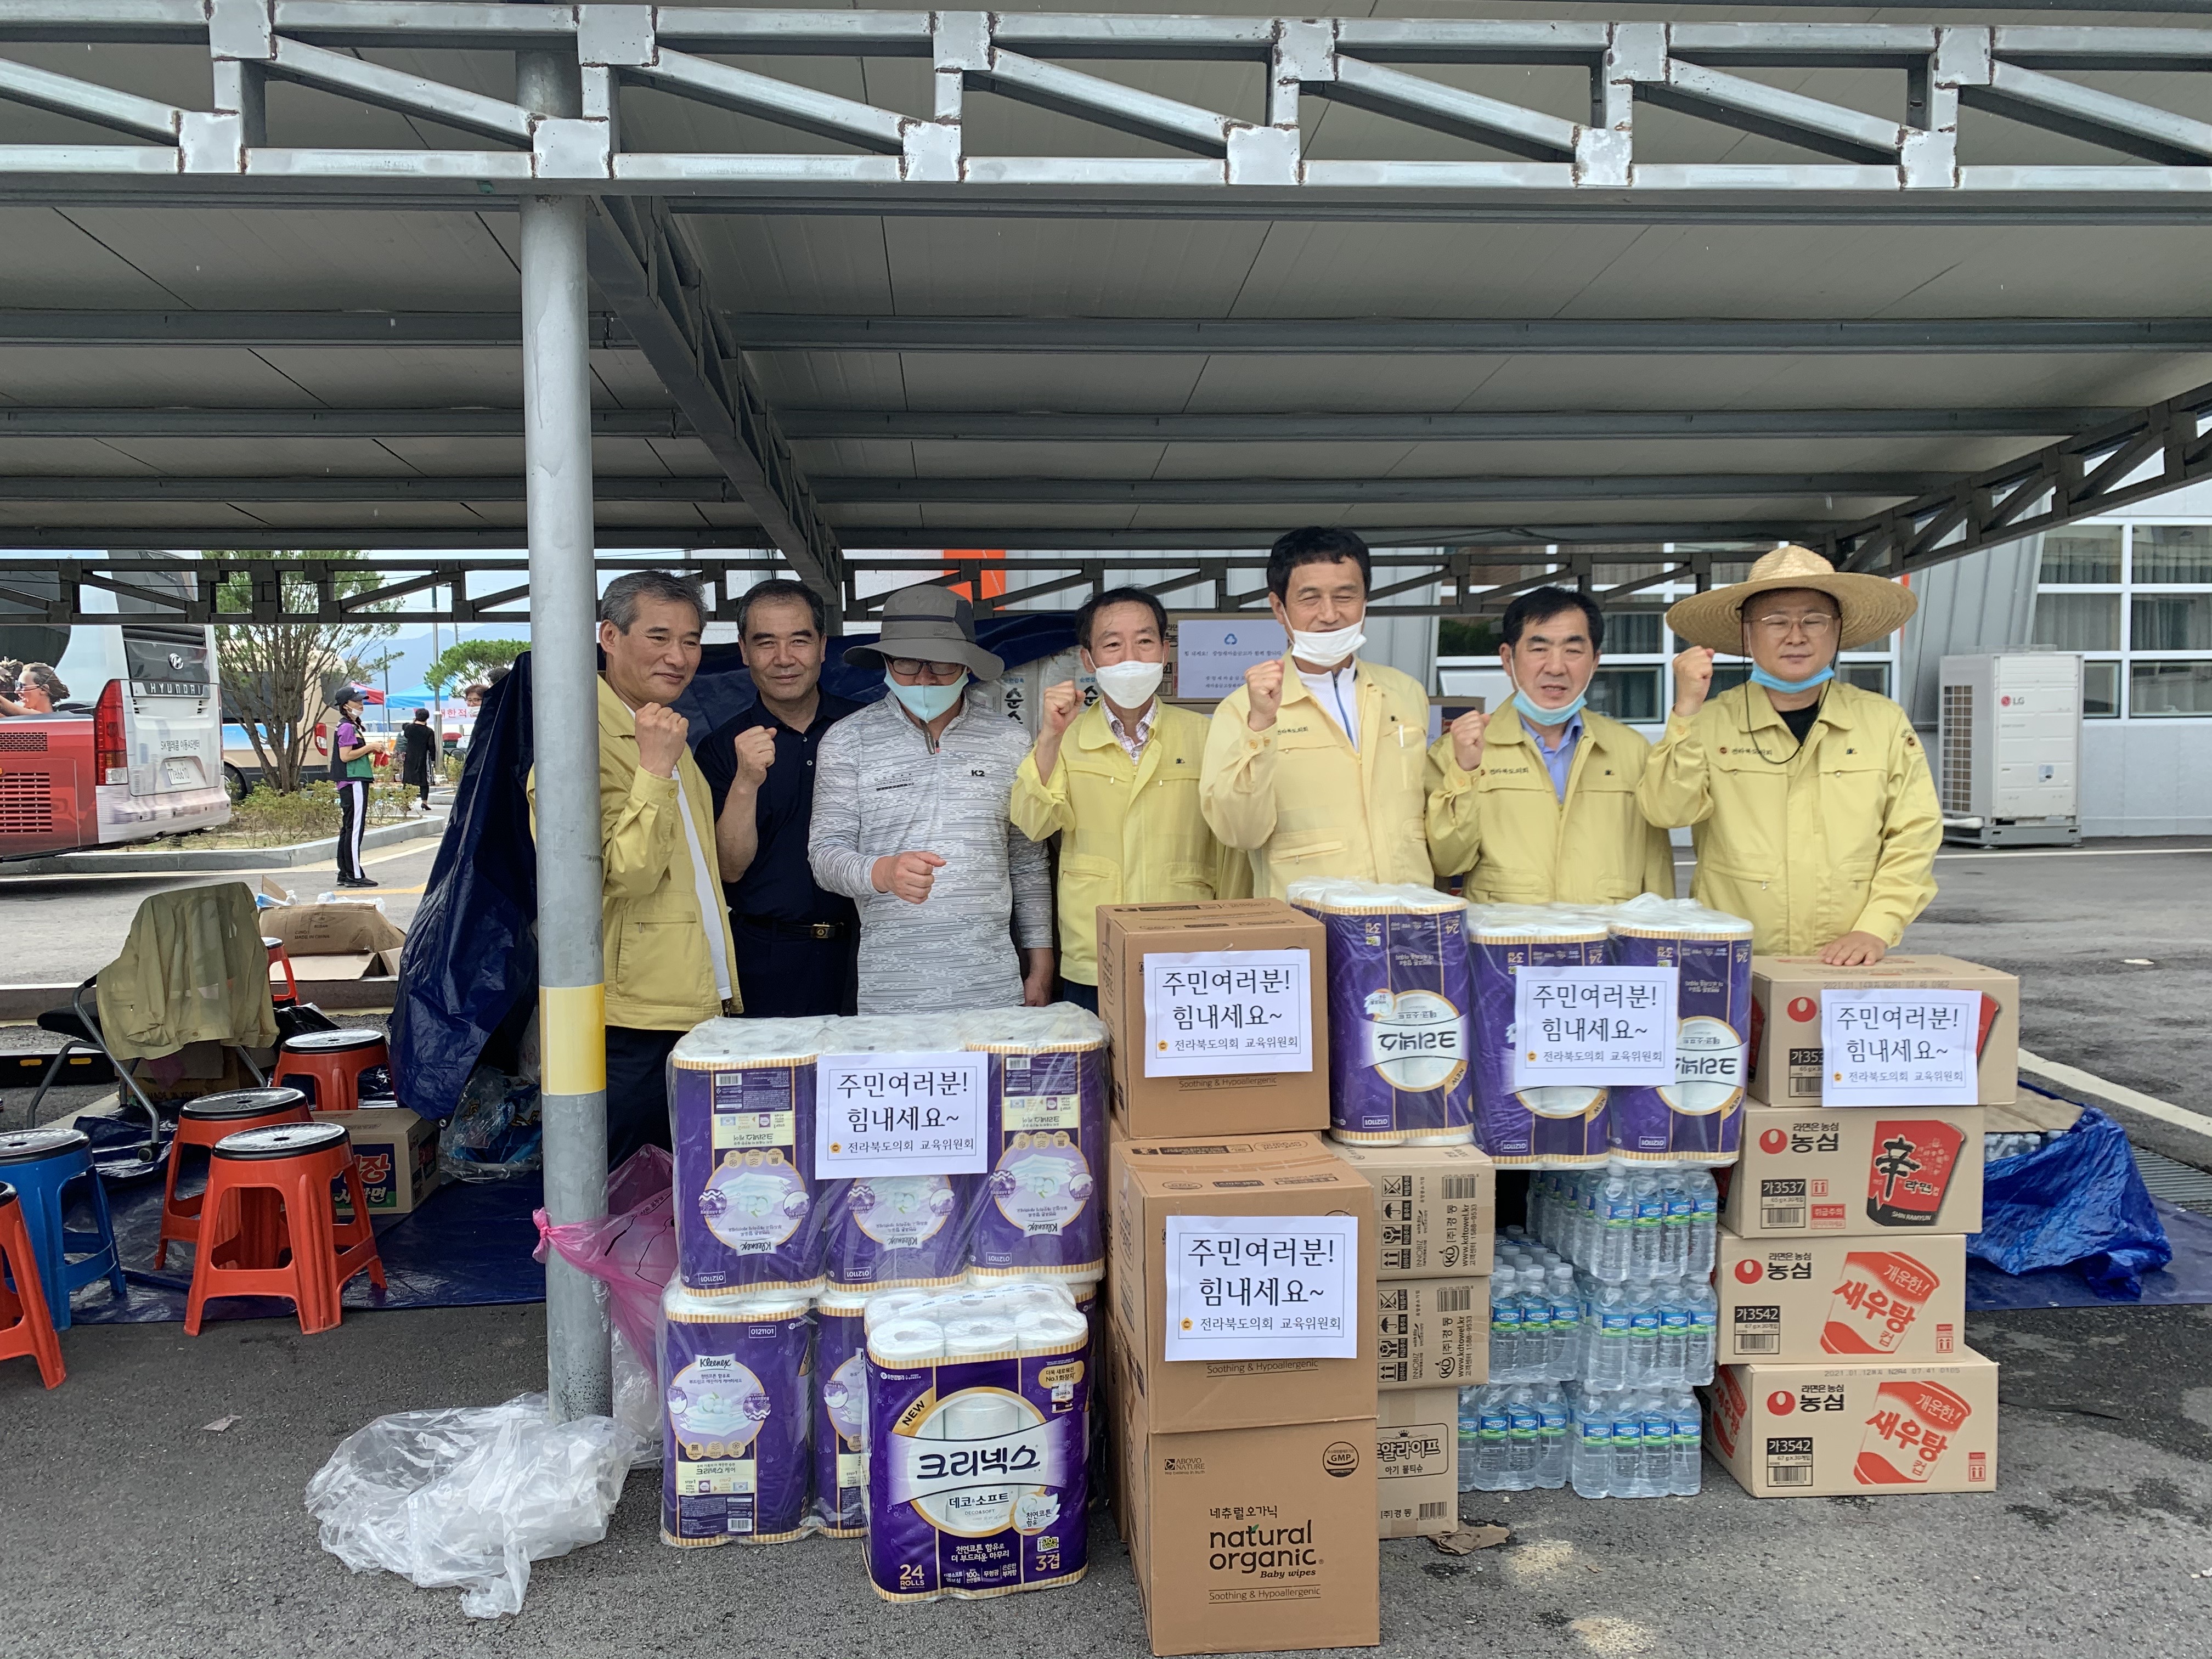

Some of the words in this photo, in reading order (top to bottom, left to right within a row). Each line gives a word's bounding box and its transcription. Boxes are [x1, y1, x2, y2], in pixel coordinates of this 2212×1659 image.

[150, 682, 201, 695] HYUNDAI
[2012, 697, 2025, 705] LG
[1161, 967, 1291, 998] 주민여러분!
[1532, 984, 1657, 1009] 주민여러분!
[1172, 1003, 1283, 1031] 힘내세요~
[1836, 1006, 1959, 1031] 주민여러분!
[1541, 1017, 1648, 1043] 힘내세요~
[1175, 1037, 1239, 1052] 전라북도의회
[1244, 1035, 1298, 1049] 교육위원회
[1378, 1031, 1457, 1051] 크리넥스
[1543, 1051, 1604, 1063] 전라북도의회
[1610, 1050, 1662, 1062] 교육위원회
[1846, 1038, 1949, 1063] 힘내세요~
[1676, 1057, 1738, 1076] 크리넥
[836, 1070, 968, 1099] 주민여러분!
[1222, 1077, 1277, 1086] Hypoallergenic
[1848, 1071, 1908, 1081] 전라북도의회
[1914, 1071, 1963, 1081] 교육위원회
[847, 1105, 960, 1133] 힘내세요~
[1793, 1122, 1820, 1132] 라면은
[1821, 1122, 1839, 1132] 농심
[847, 1139, 913, 1154] 전라북도의회
[919, 1137, 974, 1152] 교육위원회
[1791, 1133, 1839, 1153] 농심
[1874, 1135, 1921, 1200] 辛
[1763, 1181, 1805, 1195] 가3537
[1904, 1179, 1932, 1195] 라면
[1028, 1223, 1058, 1233] Kleenex
[1462, 1204, 1470, 1267] www.kdtowel.kr
[740, 1242, 772, 1251] Kleenex
[887, 1237, 918, 1246] Kleenex
[1187, 1237, 1334, 1268] 주민여러분!
[1769, 1252, 1793, 1261] 라면은
[1795, 1252, 1812, 1261] 농심
[1767, 1262, 1812, 1280] 농심
[1883, 1263, 1931, 1296] 개운한!
[1198, 1277, 1325, 1307] 힘내세요~
[1736, 1308, 1779, 1321] 가3542
[1832, 1279, 1917, 1334] 새우탕
[1200, 1316, 1273, 1331] 전라북도의회
[1279, 1316, 1341, 1331] 교육위원회
[1457, 1316, 1465, 1378] www.kdtowel.kr
[1879, 1330, 1895, 1347] 컵
[699, 1357, 732, 1368] Kleenex
[1207, 1365, 1245, 1374] Soothing
[1256, 1360, 1319, 1372] Hypoallergenic
[1801, 1385, 1827, 1393] 라면은
[1828, 1384, 1844, 1393] 농심
[1799, 1393, 1844, 1413] 농심
[1915, 1393, 1962, 1425] 개운한!
[901, 1400, 925, 1426] NEW
[1865, 1410, 1949, 1463] 새우탕
[1768, 1440, 1811, 1453] 가3542
[917, 1444, 1041, 1480] 크리넥스
[1331, 1454, 1351, 1462] GMP
[1385, 1465, 1400, 1475] 아기
[1402, 1464, 1424, 1475] 물티슈
[1912, 1459, 1927, 1476] 컵
[1026, 1509, 1052, 1519] 천연코튼
[1210, 1506, 1244, 1520] 네츄럴
[1246, 1505, 1278, 1519] 오가닉
[1026, 1519, 1038, 1528] 함유
[1210, 1519, 1312, 1548] natural
[956, 1544, 984, 1554] 천연코튼
[985, 1543, 1005, 1551] 함유로
[960, 1553, 988, 1562] 부드러운
[989, 1550, 1010, 1559] 마무리
[1035, 1553, 1060, 1572] 3겹
[1210, 1548, 1317, 1574] organic
[900, 1564, 925, 1581] 24
[983, 1569, 1000, 1578] 무형광
[1260, 1570, 1285, 1579] Baby
[1288, 1569, 1317, 1578] wipes
[1209, 1591, 1247, 1601] Soothing
[1249, 1590, 1256, 1598] &
[1259, 1587, 1322, 1598] Hypoallergenic
